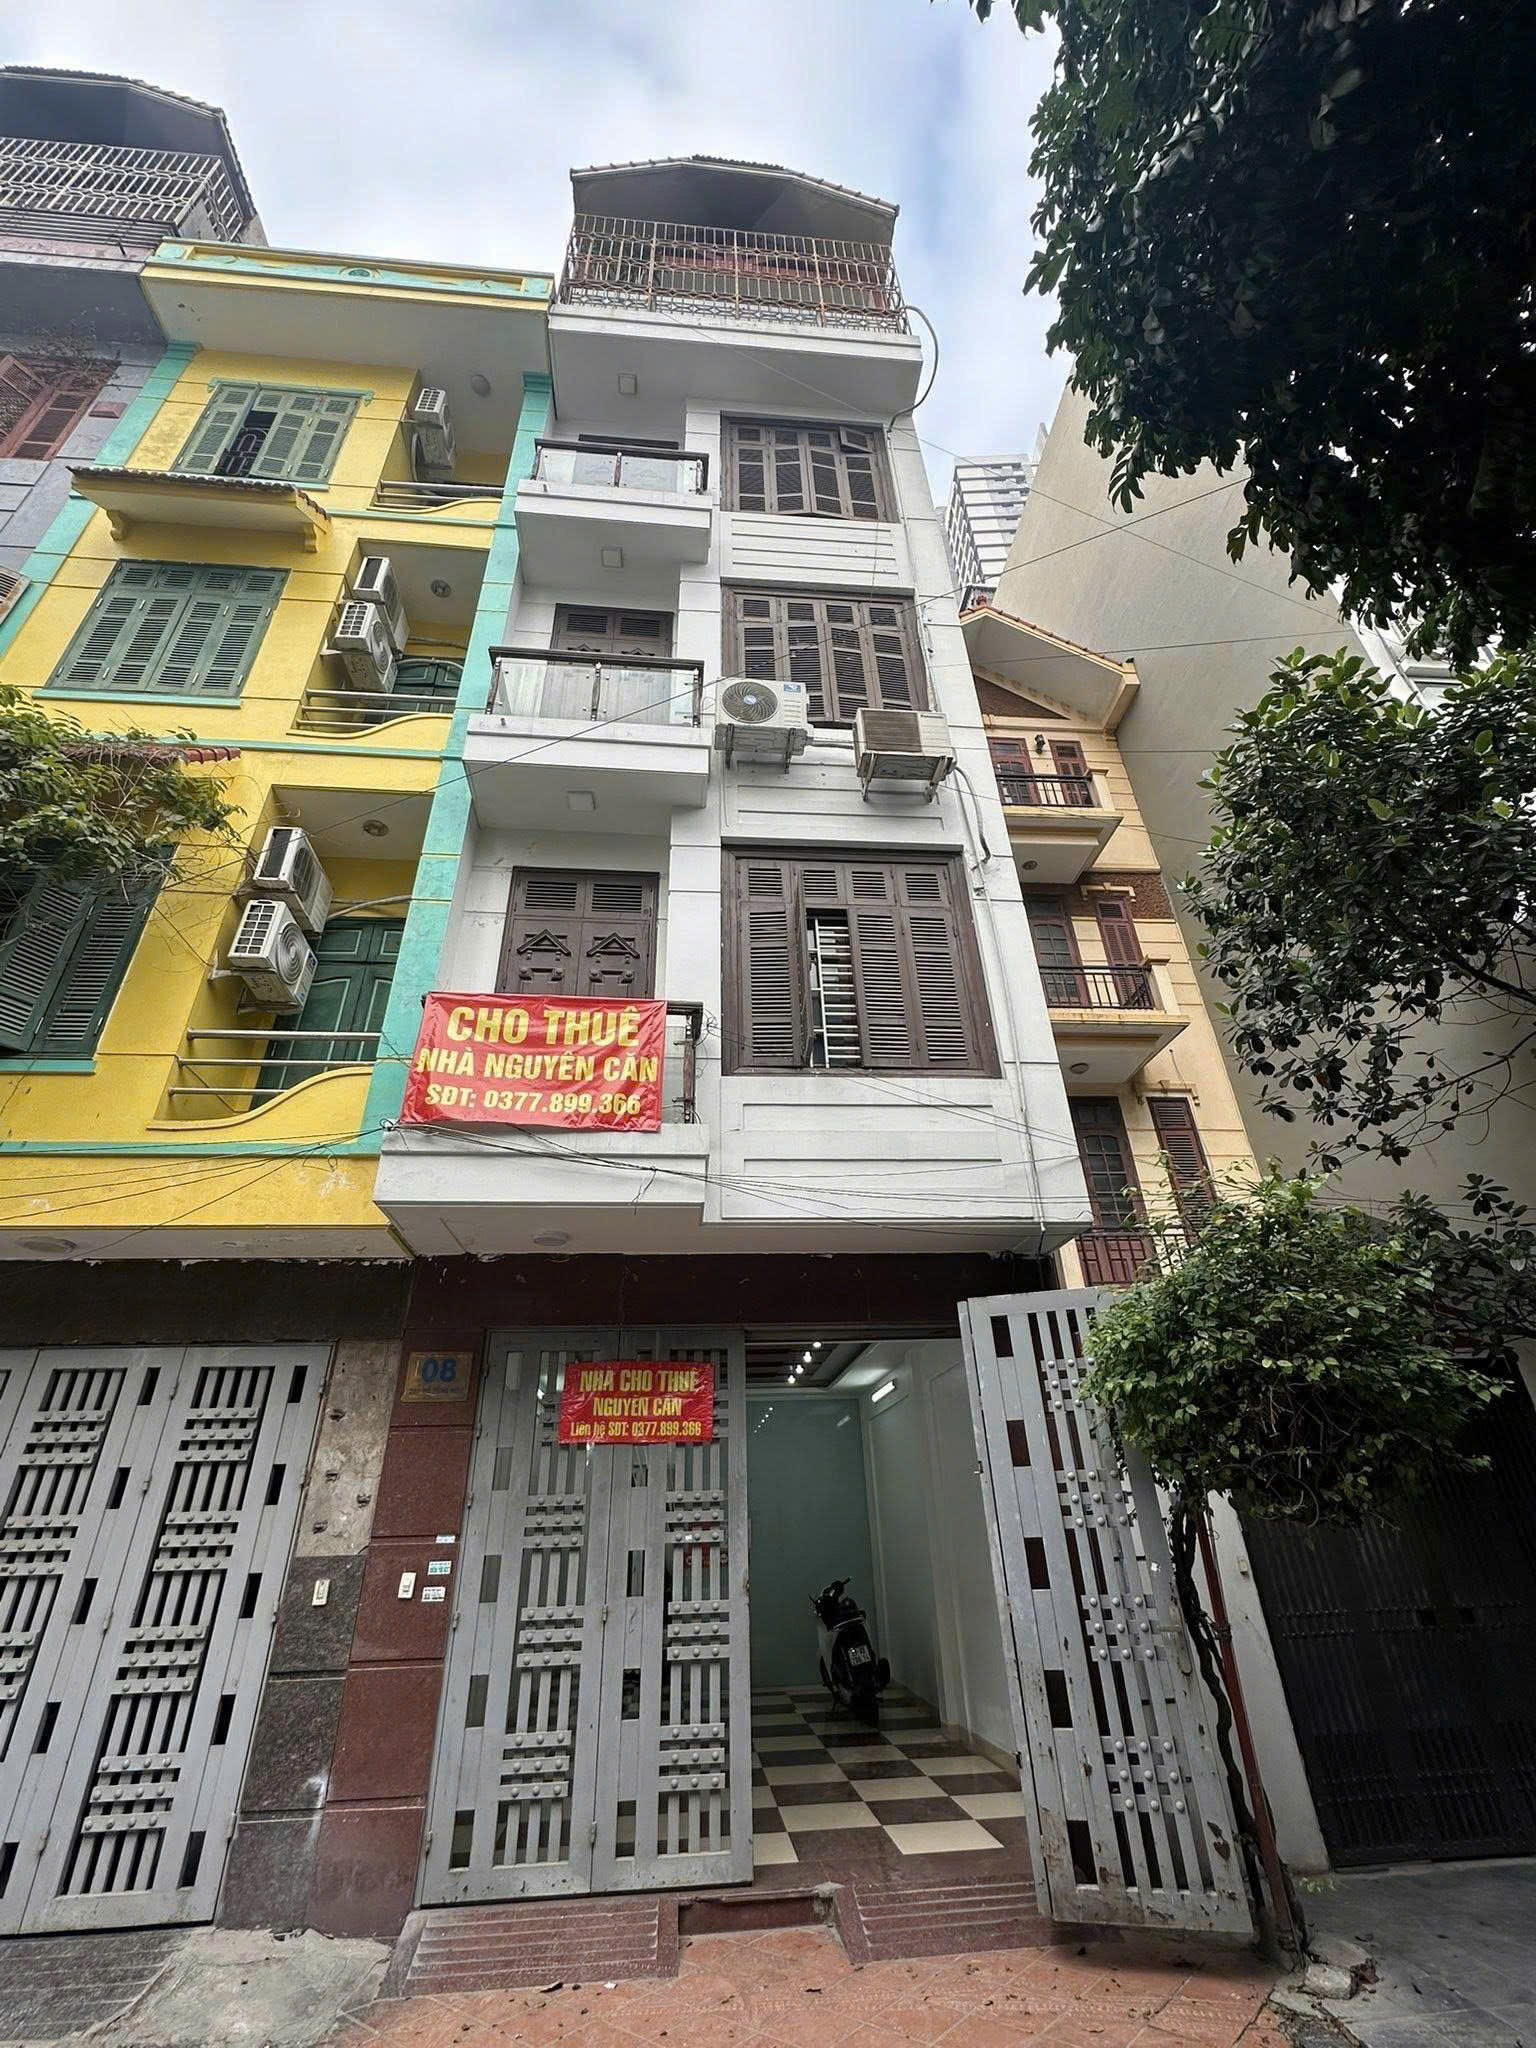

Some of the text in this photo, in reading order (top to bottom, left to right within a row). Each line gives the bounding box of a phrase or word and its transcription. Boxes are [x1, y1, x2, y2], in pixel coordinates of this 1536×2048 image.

[447, 1005, 641, 1047] CHO THUÊ
[416, 1047, 658, 1082] NHÀ NGUYÊN CĂN
[424, 1083, 641, 1115] SĐT: 0377.899.366
[422, 1358, 457, 1383] 08
[579, 1366, 698, 1392] NHÀ CHO THUÊ
[632, 1421, 702, 1437] 0377.899.366
